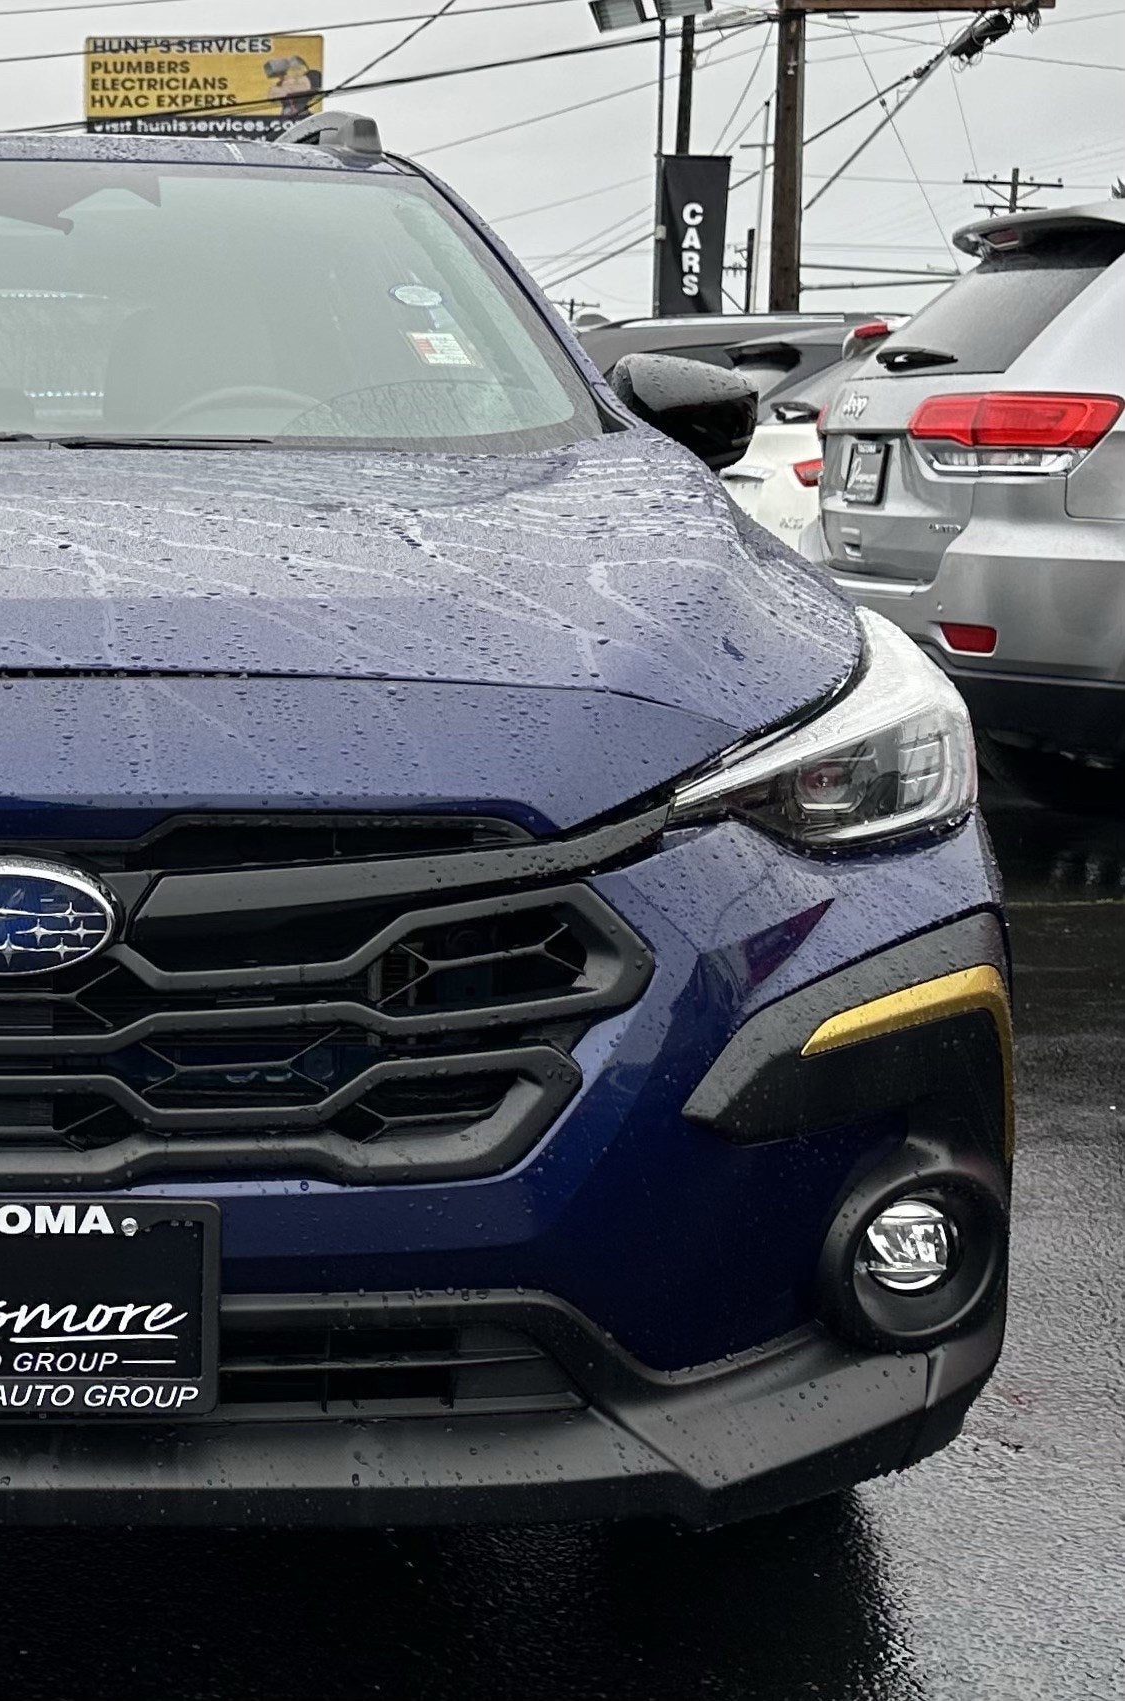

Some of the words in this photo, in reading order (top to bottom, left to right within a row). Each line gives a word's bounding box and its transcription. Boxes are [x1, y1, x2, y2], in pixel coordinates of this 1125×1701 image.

[92, 38, 172, 54] HUNT'S
[176, 37, 273, 54] SERVICES
[90, 60, 191, 75] PLUMBERS
[90, 77, 229, 92] ELECTRICIANS
[90, 94, 150, 109] HVAC
[155, 94, 236, 109] EXPERTS
[681, 201, 704, 297] CARS
[12, 1352, 119, 1373] GROUP
[83, 1385, 199, 1409] GROUP
